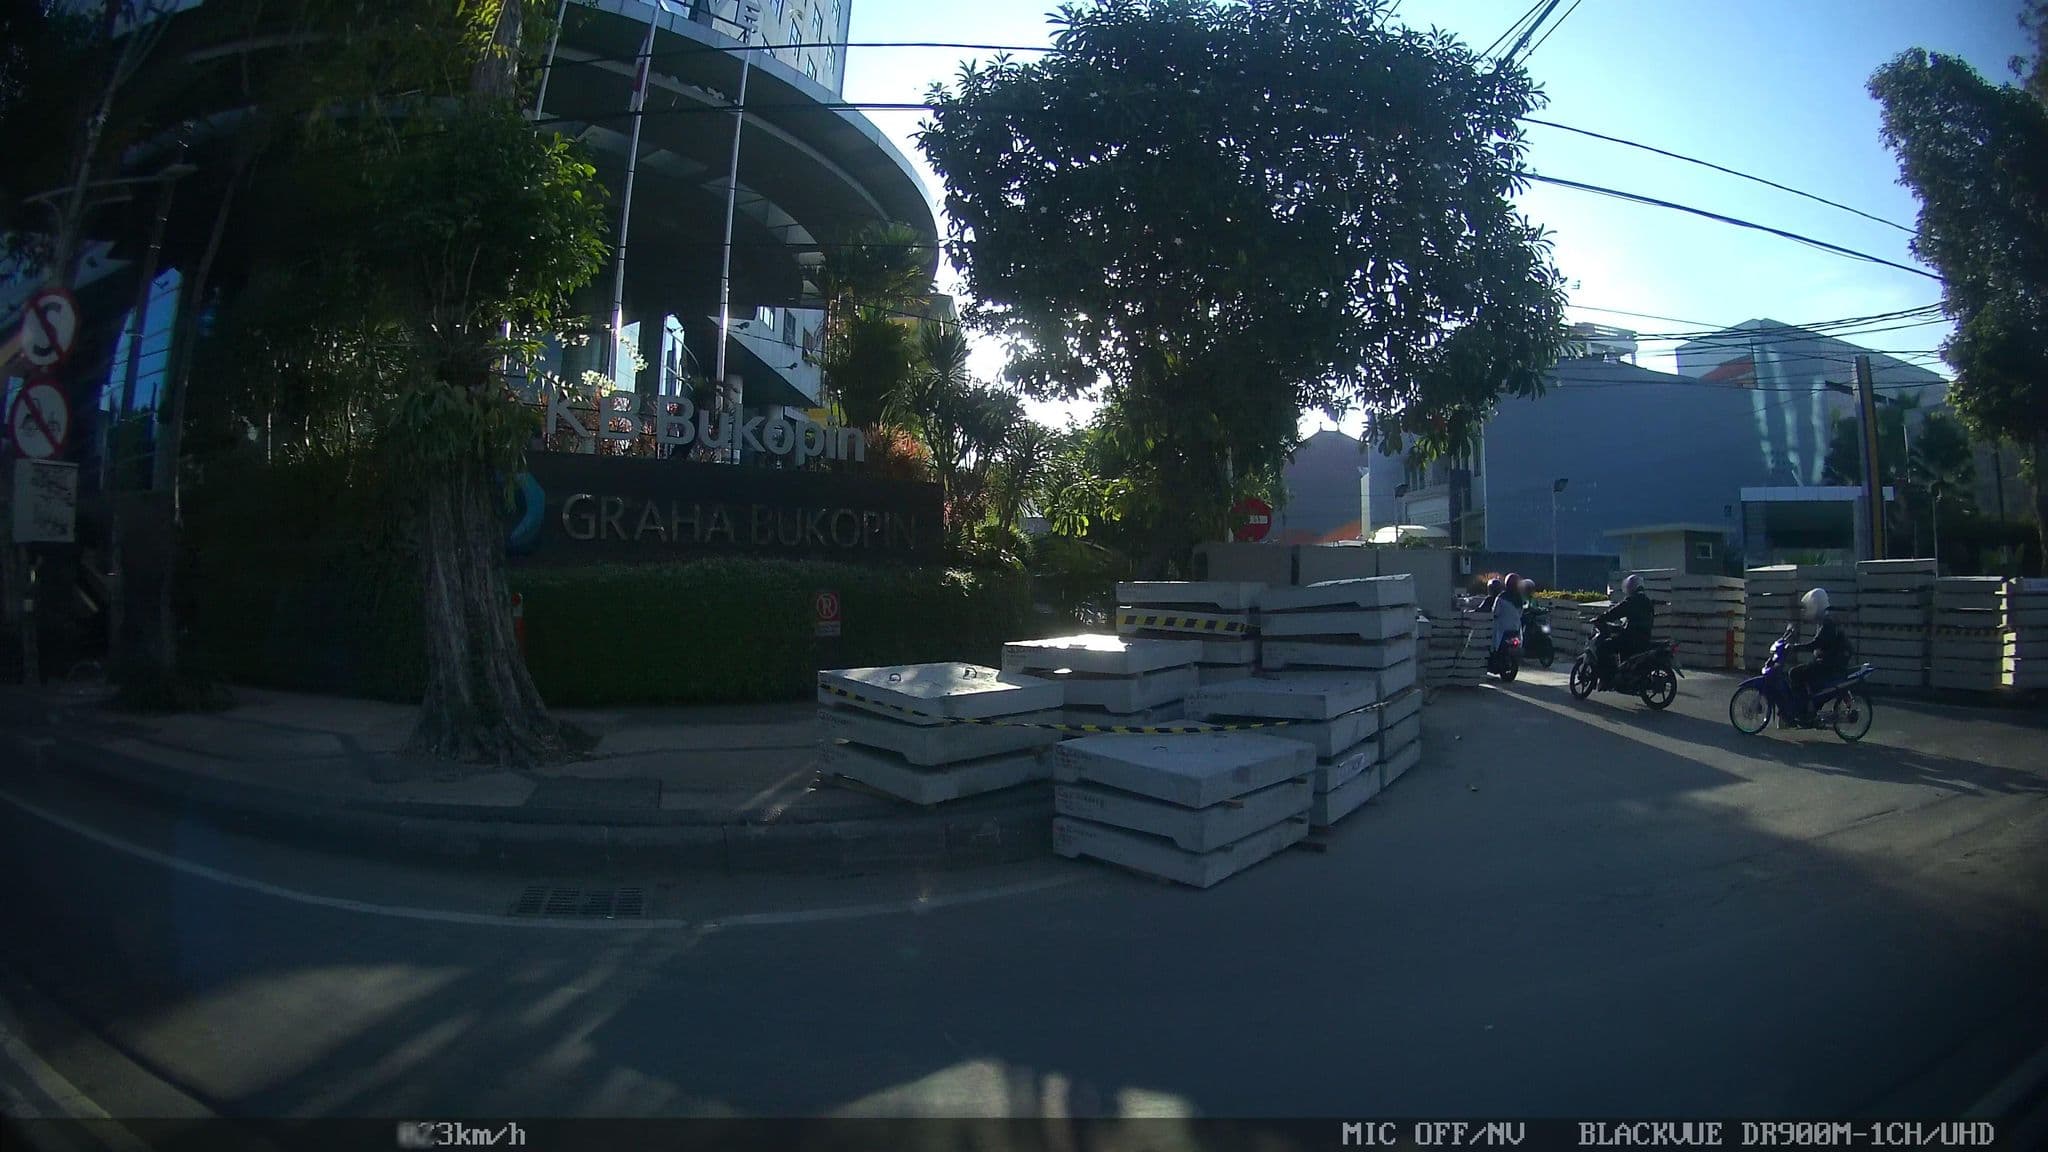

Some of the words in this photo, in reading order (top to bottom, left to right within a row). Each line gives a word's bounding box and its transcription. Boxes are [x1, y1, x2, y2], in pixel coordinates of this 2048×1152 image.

[656, 396, 866, 466] Bukopin
[562, 492, 737, 545] GRAHA
[750, 504, 917, 549] BUKOPIN
